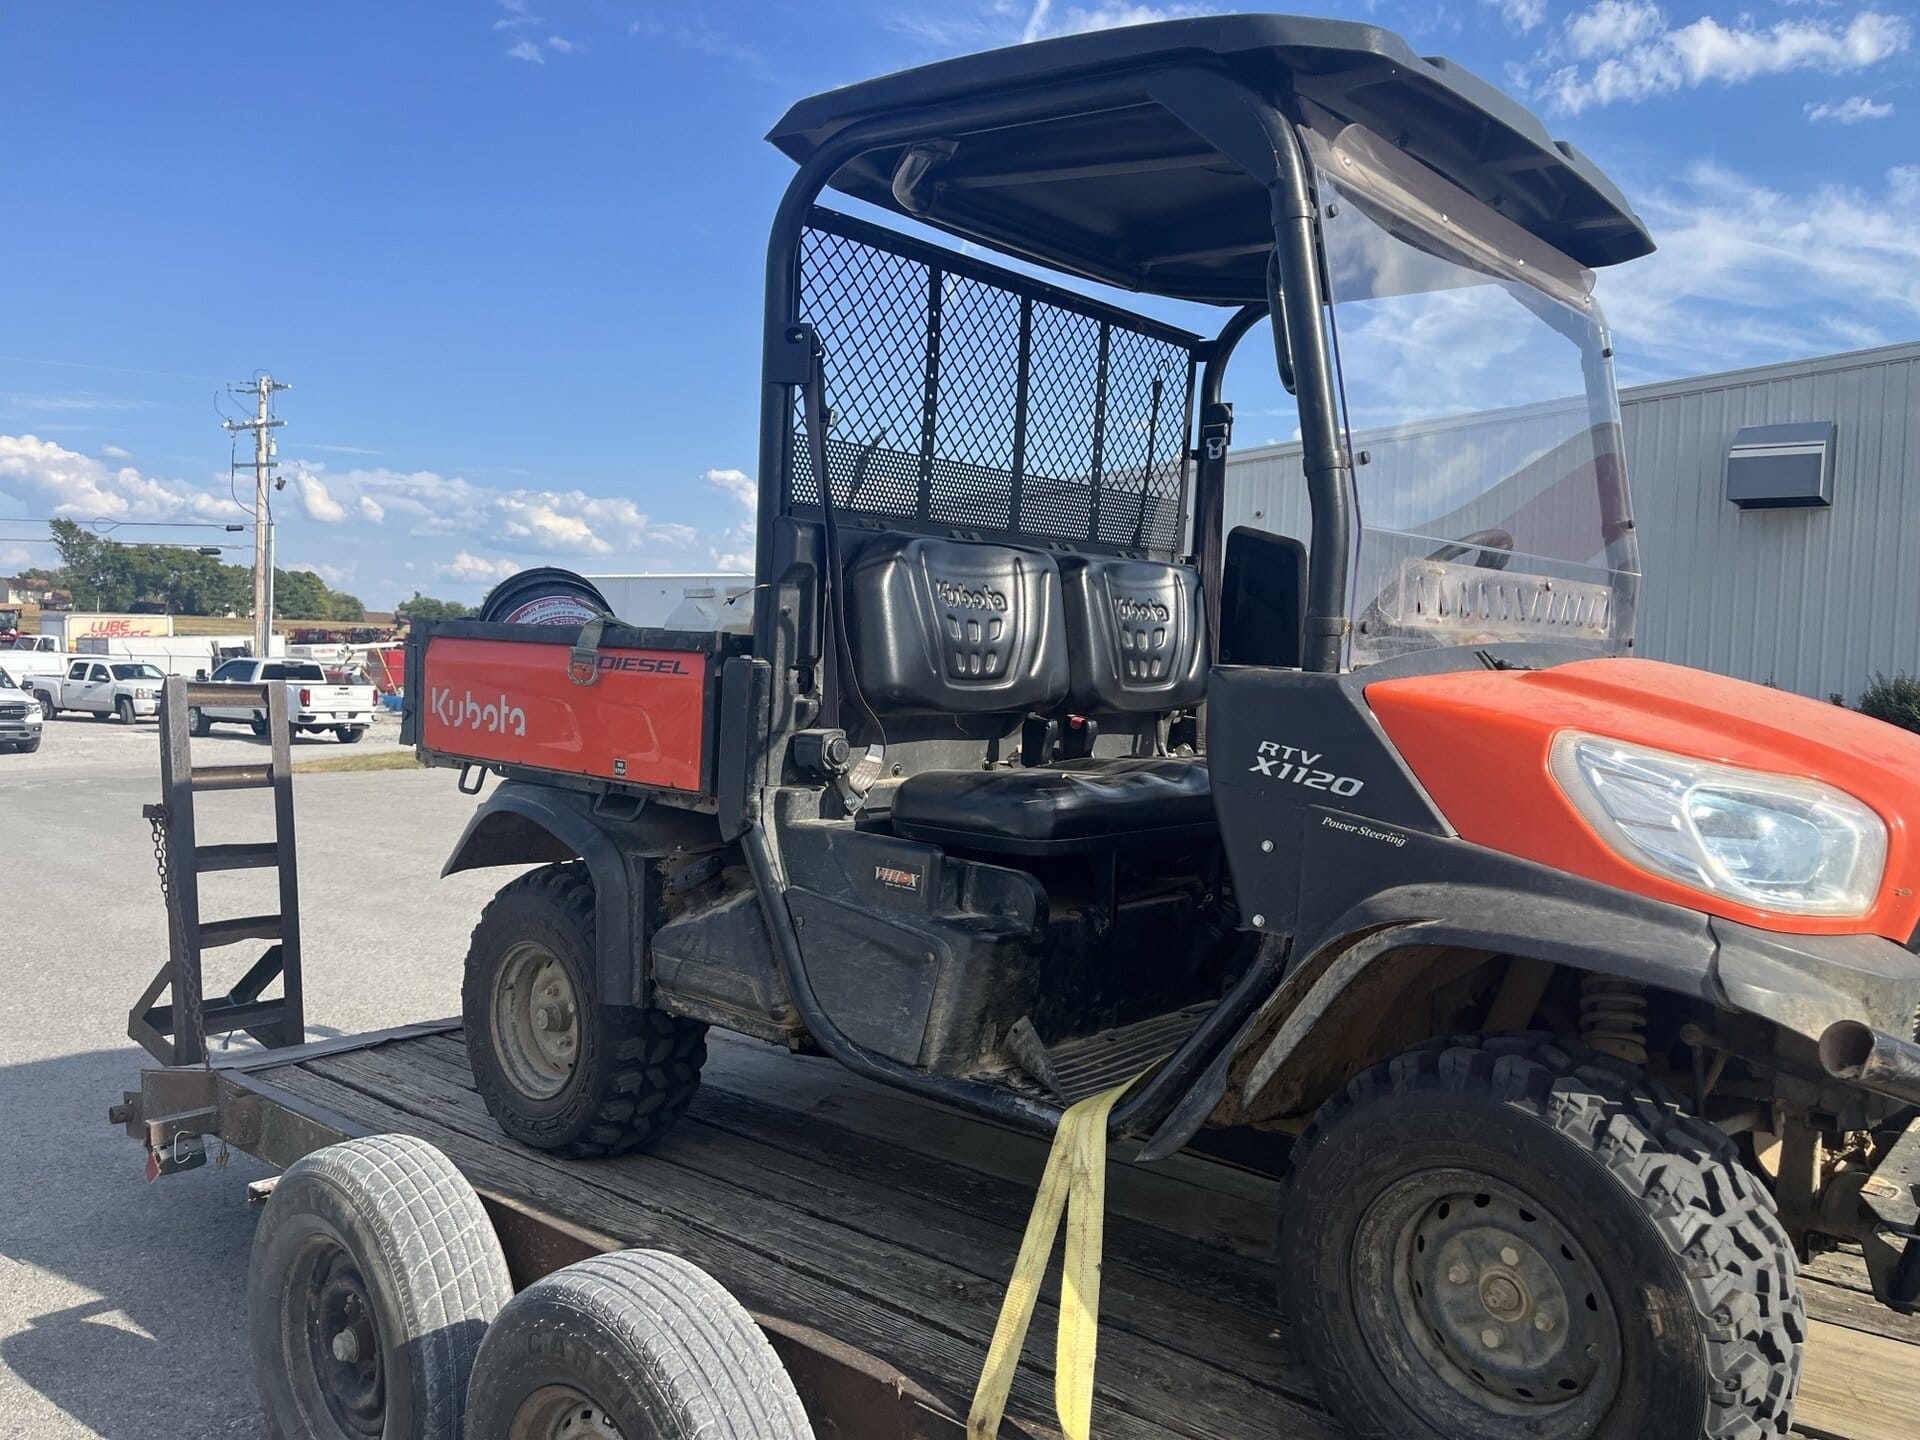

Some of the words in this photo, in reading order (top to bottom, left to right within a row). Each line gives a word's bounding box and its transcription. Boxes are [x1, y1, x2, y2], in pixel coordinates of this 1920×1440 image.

[936, 579, 1009, 612] Kubota
[1114, 597, 1170, 622] Kubota
[90, 619, 131, 633] LUBE
[597, 655, 690, 675] DIESEL
[431, 687, 526, 737] Kubota
[1257, 740, 1323, 765] RTV
[1248, 755, 1365, 797] X1120
[1321, 816, 1358, 833] Power
[1357, 825, 1407, 848] Steering
